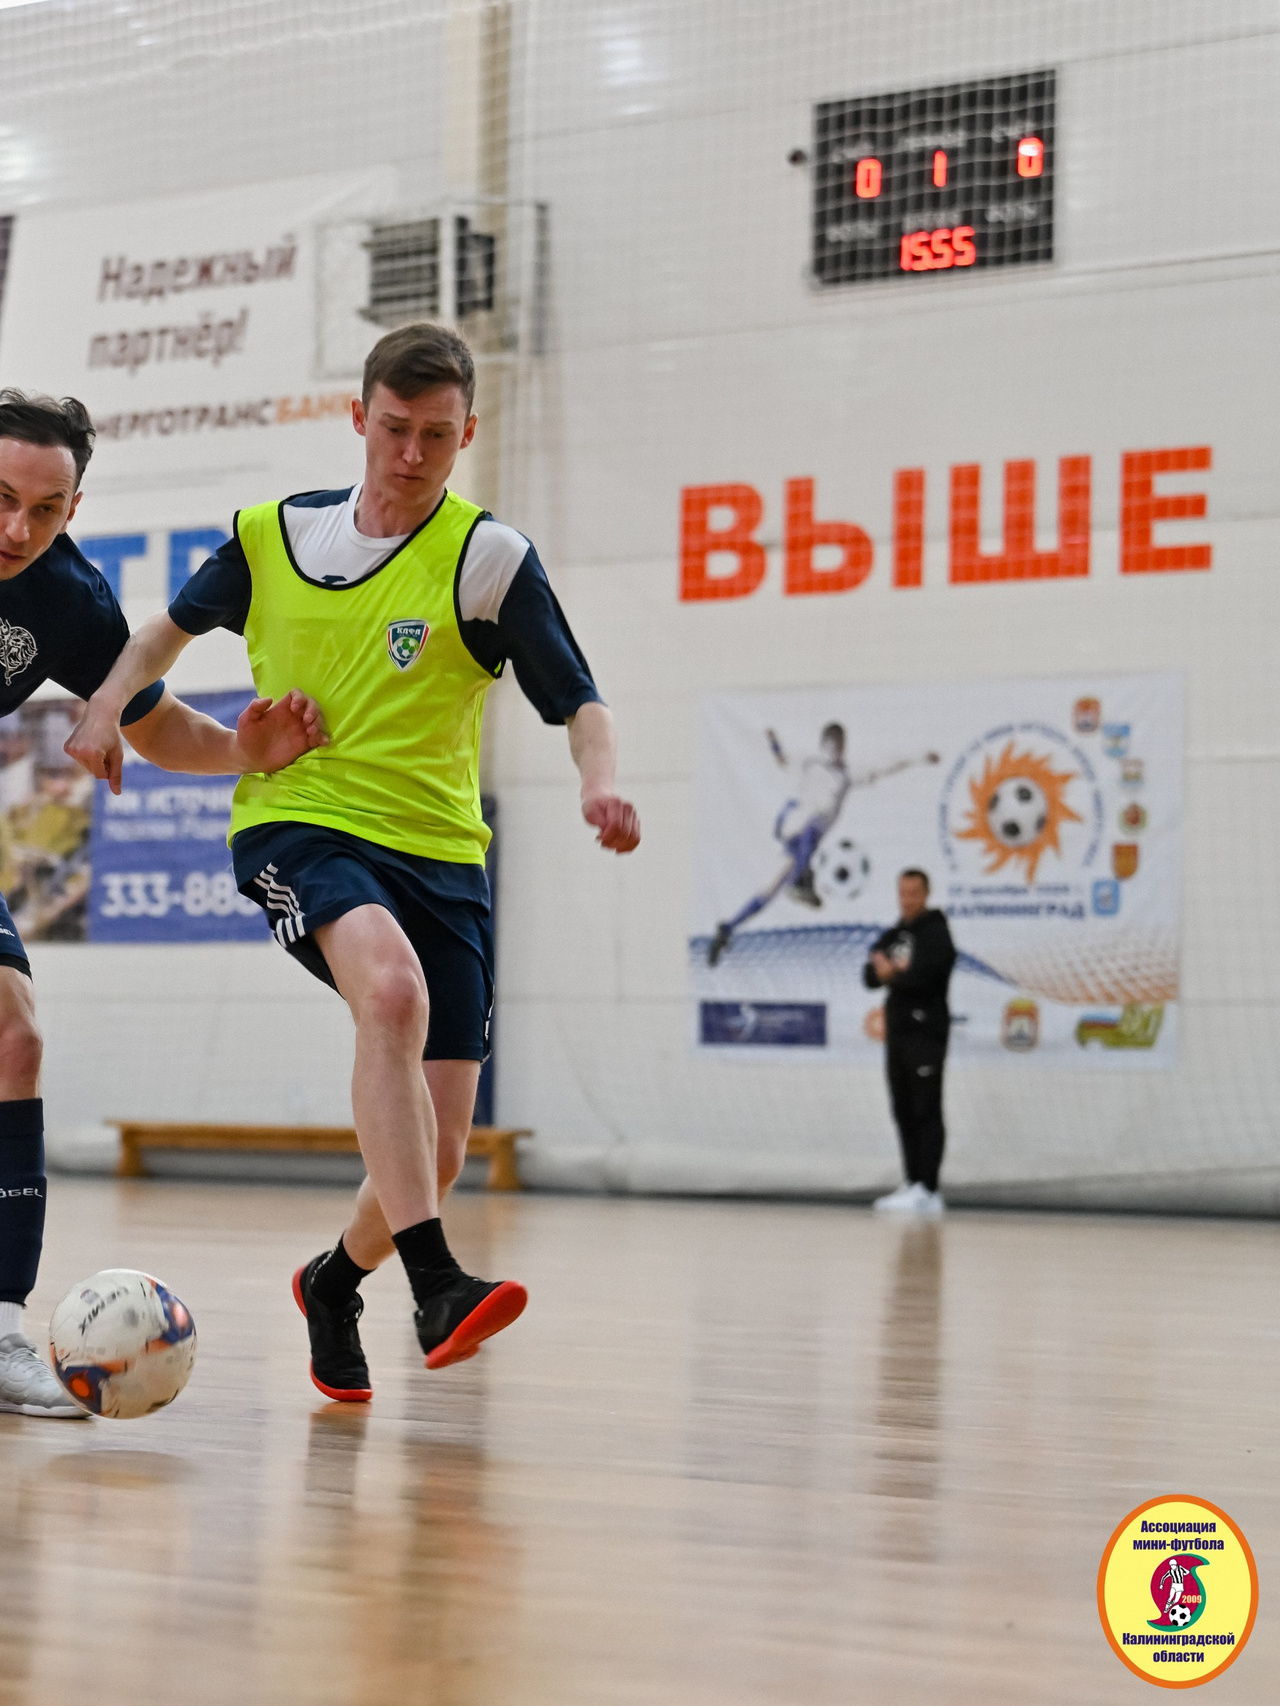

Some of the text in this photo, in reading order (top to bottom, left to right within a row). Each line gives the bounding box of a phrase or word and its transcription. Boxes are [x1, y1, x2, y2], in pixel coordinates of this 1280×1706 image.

[856, 157, 882, 198] 0
[933, 150, 948, 188] 1
[95, 233, 297, 304] Надежный
[86, 306, 247, 376] партнёр!
[679, 446, 1212, 602] ВЫШЕ
